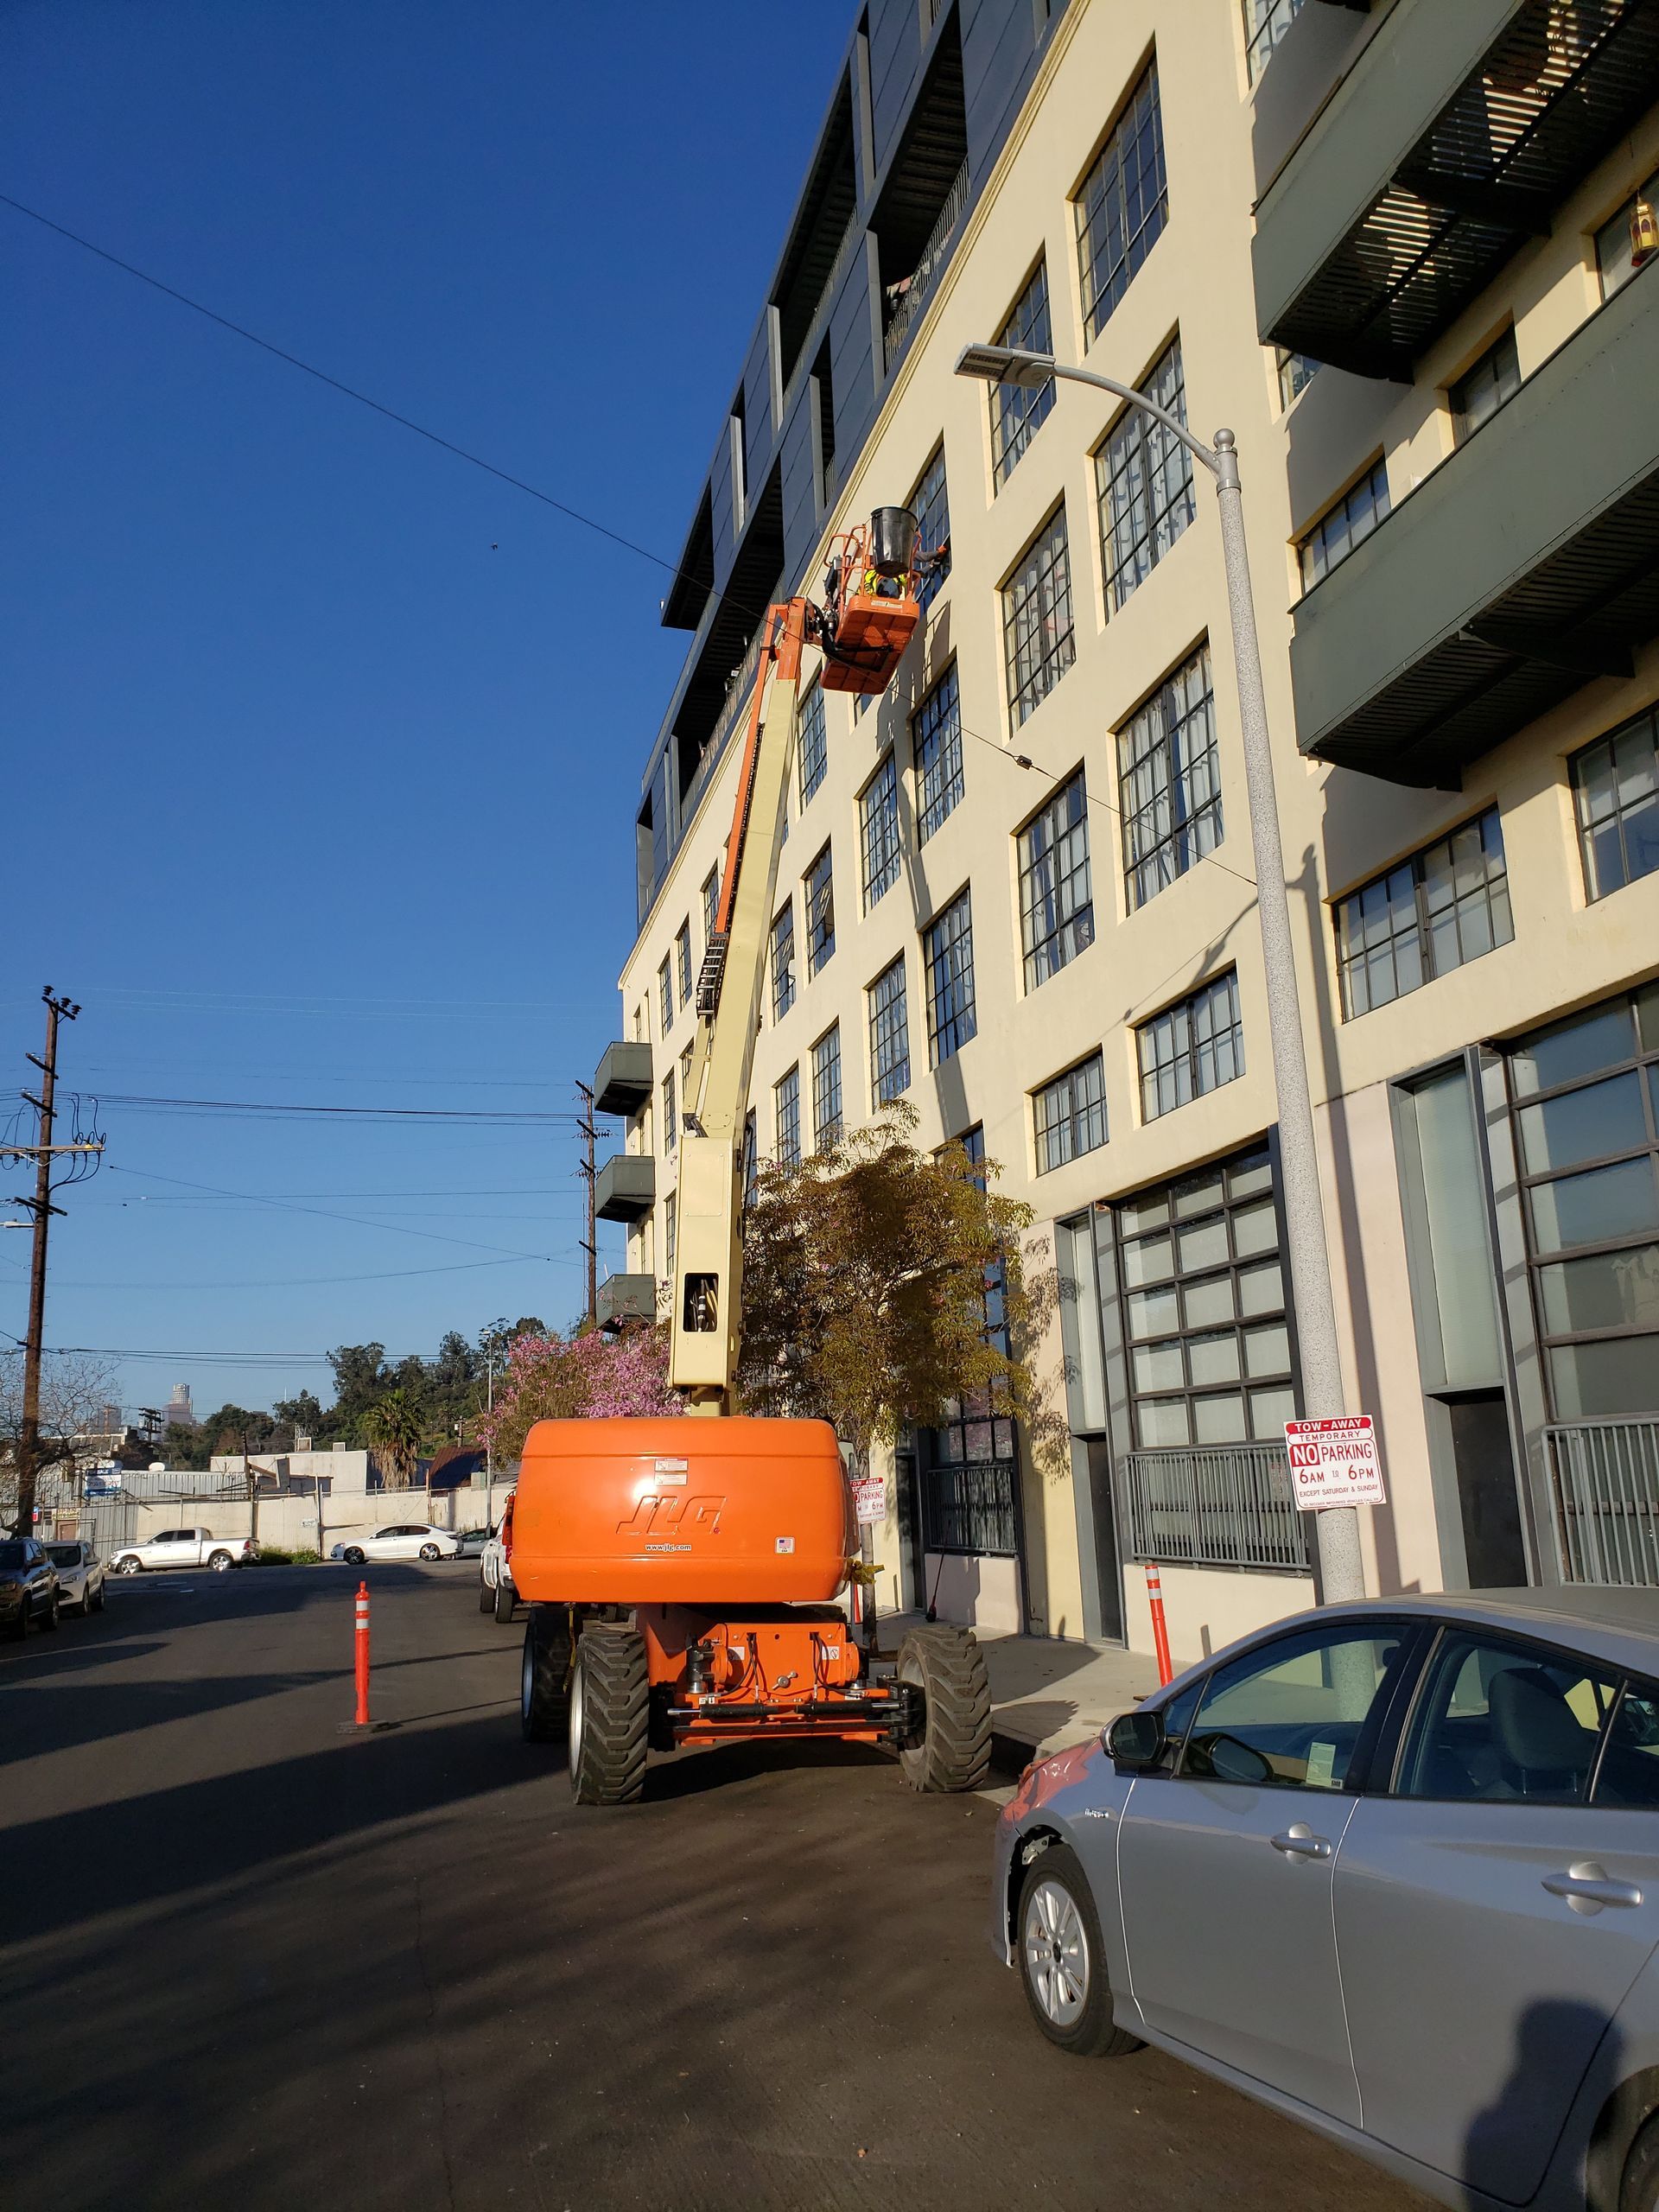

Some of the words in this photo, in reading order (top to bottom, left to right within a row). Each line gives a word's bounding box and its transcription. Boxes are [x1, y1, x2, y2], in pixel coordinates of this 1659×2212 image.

[1300, 1431, 1361, 1442] TEMPORARY
[1293, 1445, 1319, 1465] NO
[1321, 1443, 1371, 1461] PARKING
[861, 1491, 883, 1502] PARKING
[1322, 1487, 1348, 1496] SATURDAY
[615, 1496, 726, 1535] JLG
[645, 1543, 691, 1552] www.jlg.com
